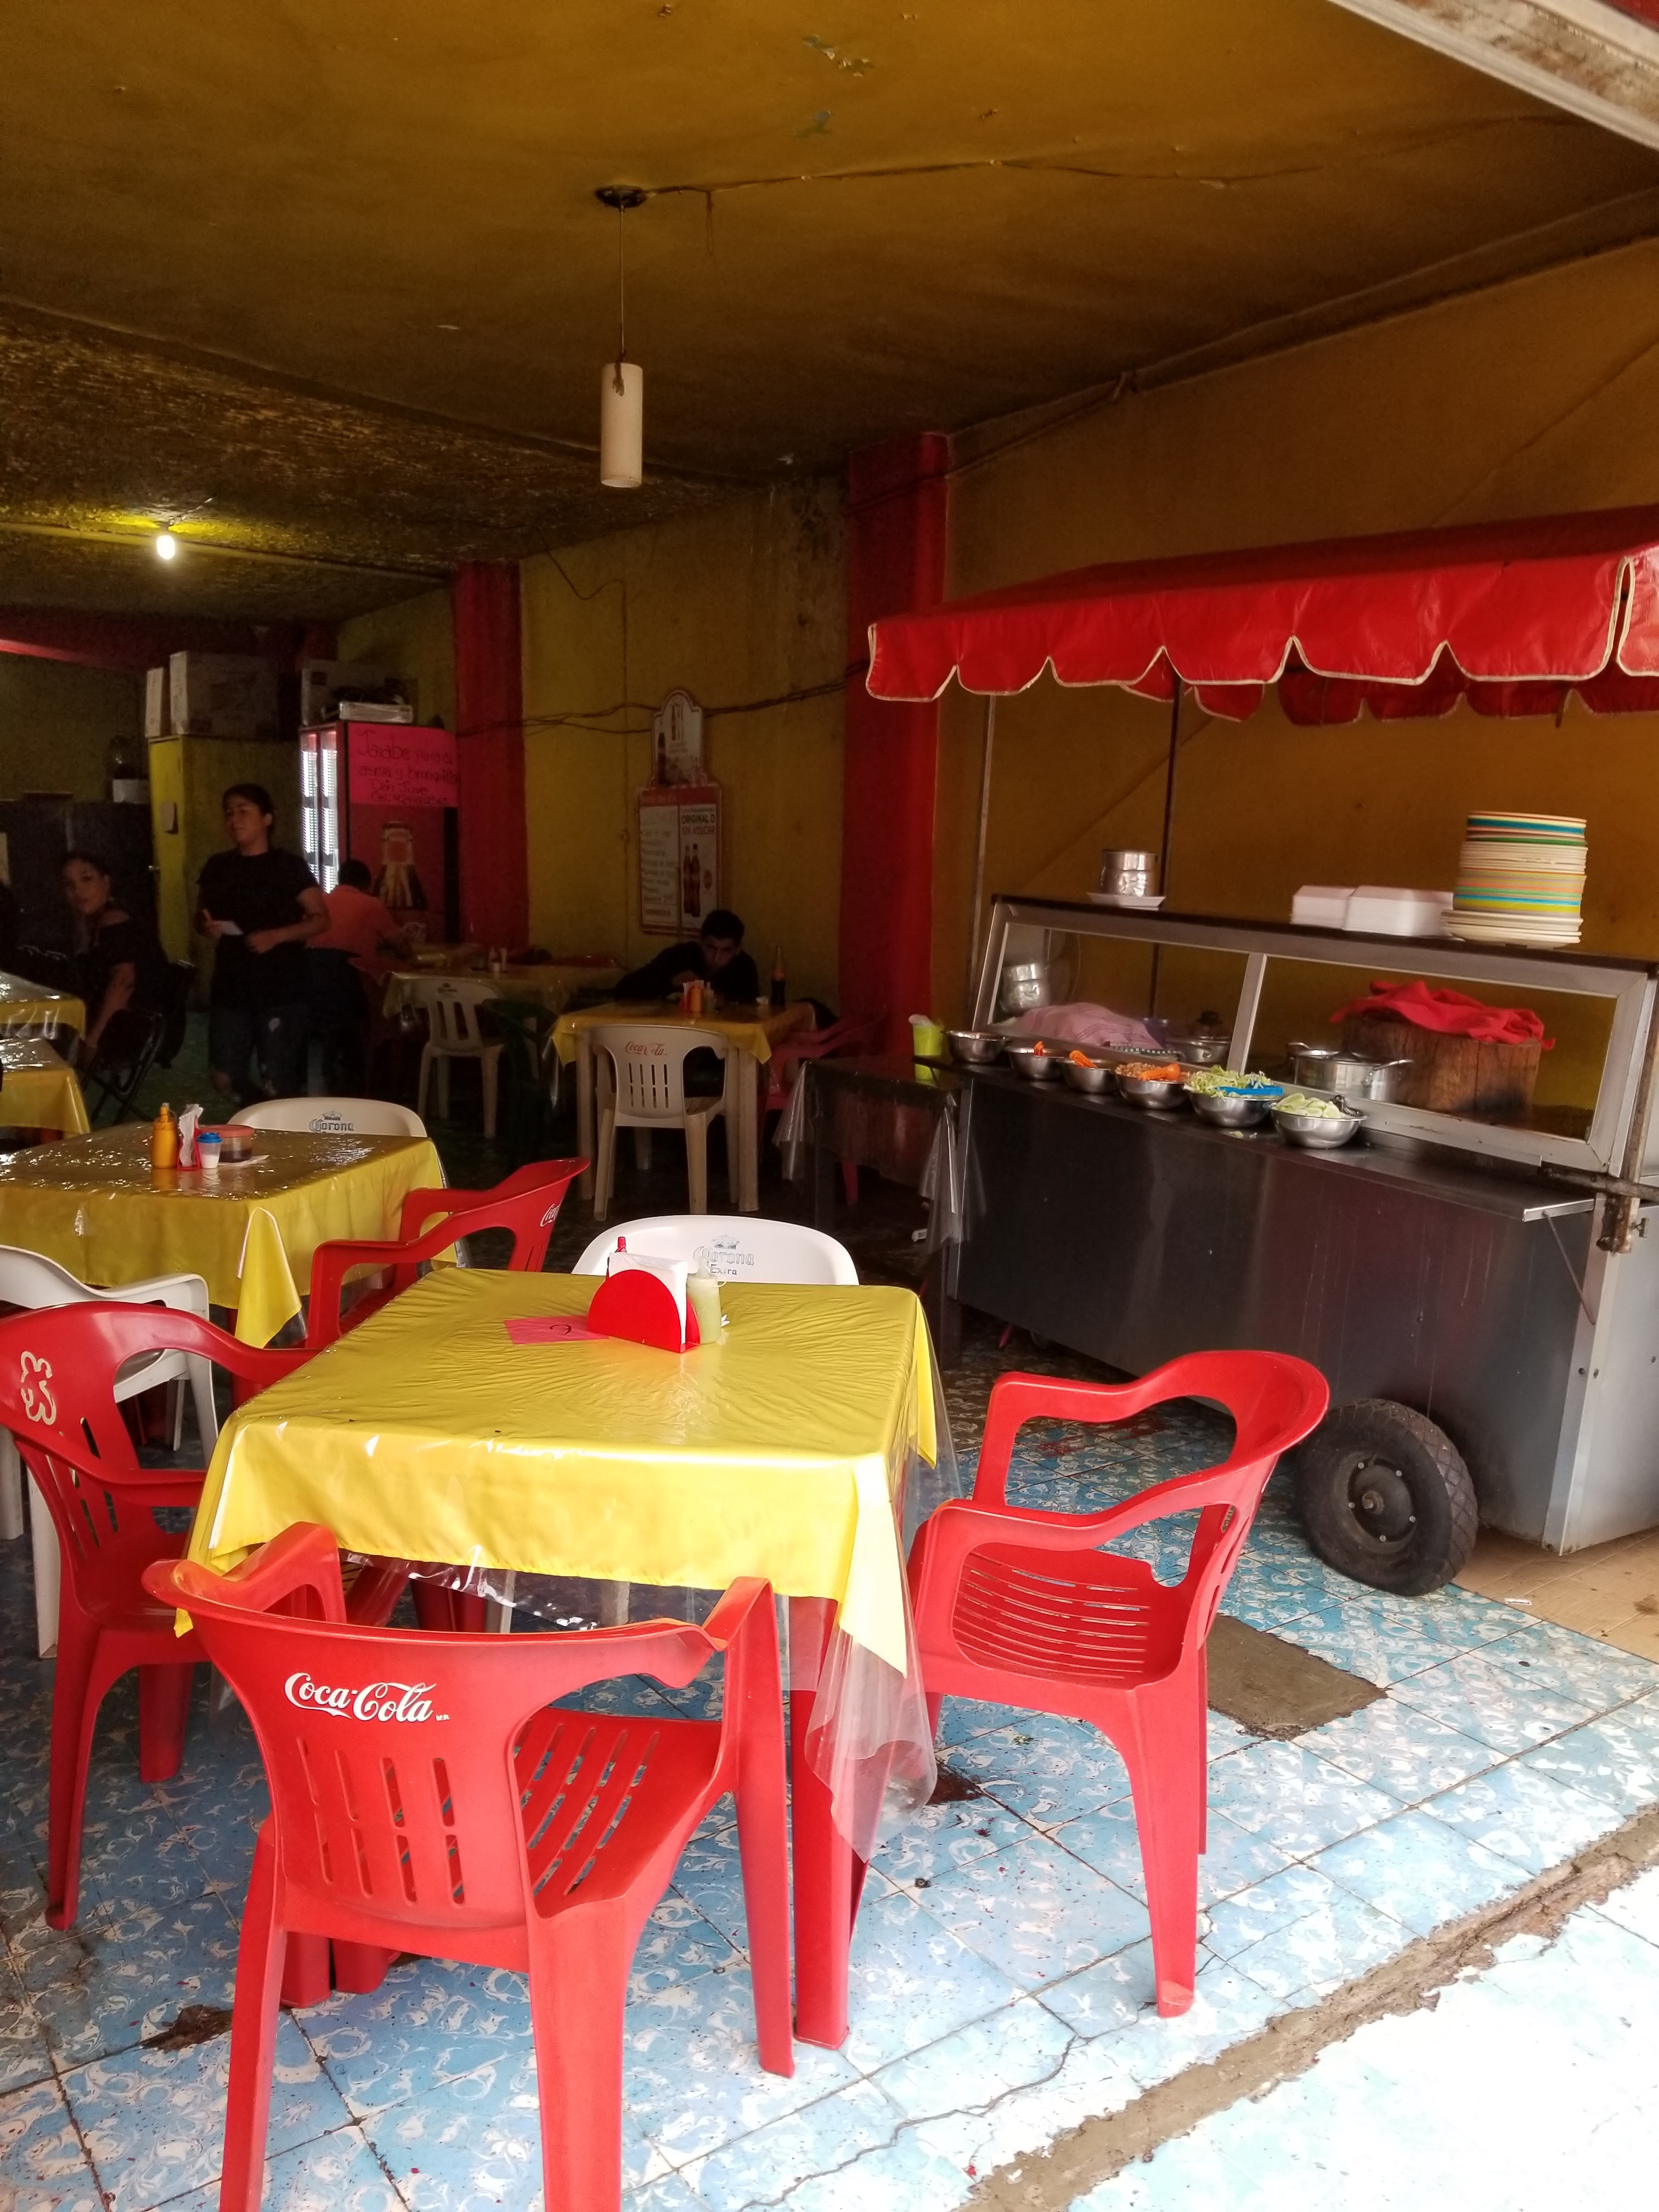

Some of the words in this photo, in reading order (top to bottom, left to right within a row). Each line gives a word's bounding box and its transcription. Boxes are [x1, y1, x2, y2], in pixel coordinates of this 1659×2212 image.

[681, 814, 709, 823] ORIGINAL
[309, 1119, 354, 1133] Corona
[693, 1246, 754, 1266] Corona
[710, 1263, 737, 1276] Exra
[284, 1672, 437, 1723] Coca-Cola
